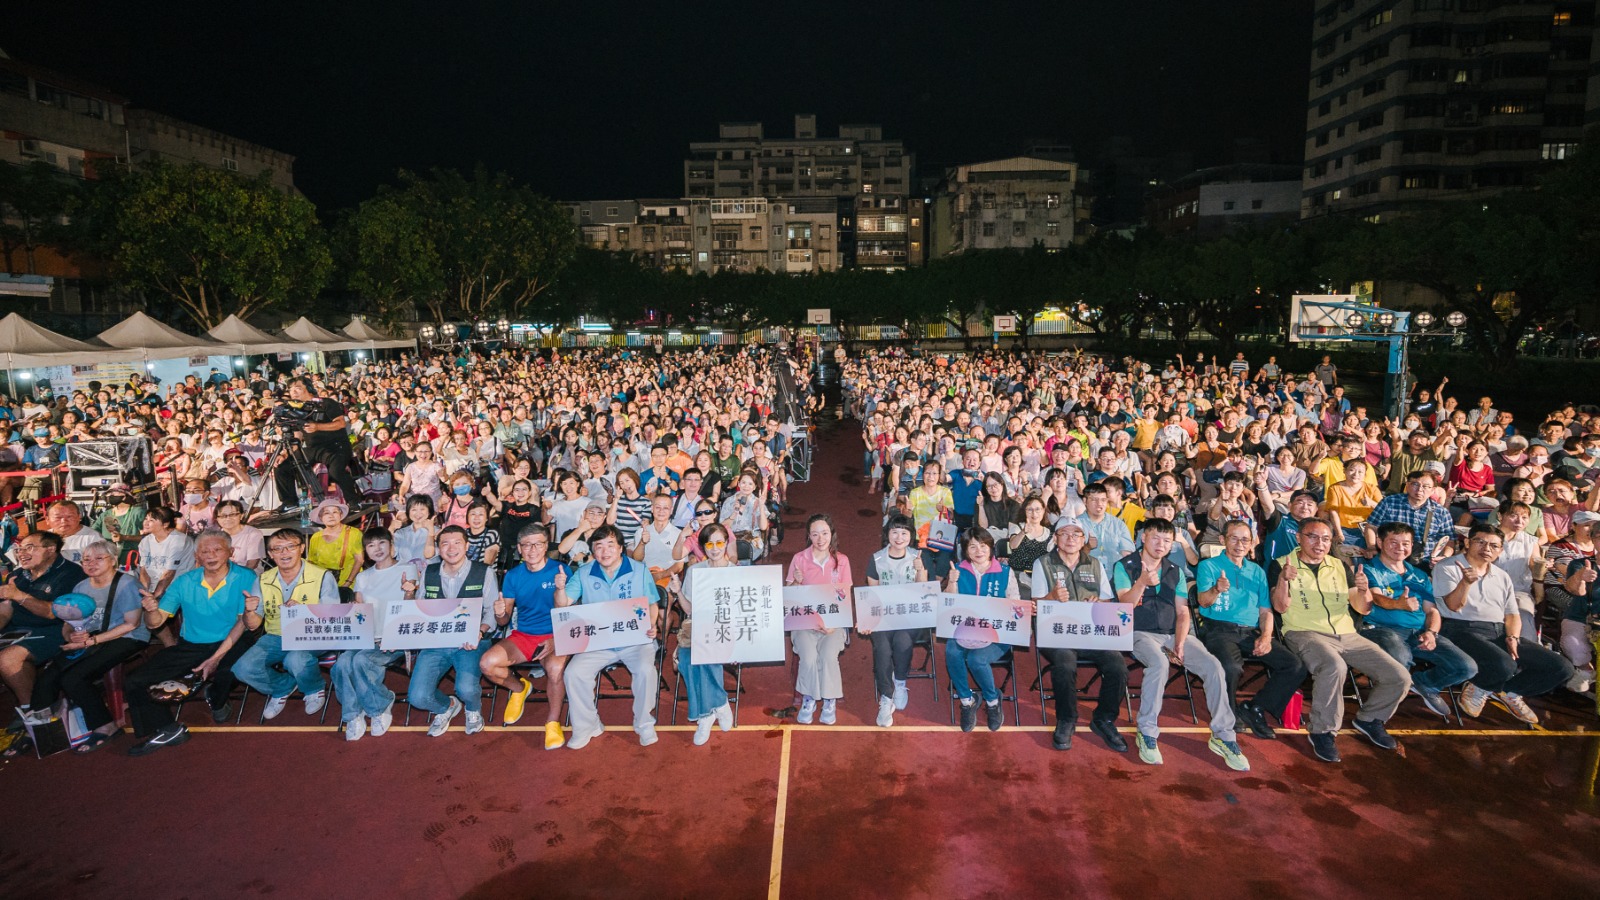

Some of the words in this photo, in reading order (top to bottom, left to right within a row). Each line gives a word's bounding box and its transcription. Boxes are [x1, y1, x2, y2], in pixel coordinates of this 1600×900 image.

[761, 584, 772, 609] 新北
[713, 586, 731, 643] 藝起來
[734, 586, 758, 642] 巷弄
[870, 601, 933, 617] 新北藝起來
[304, 617, 327, 625] 08.16
[328, 616, 352, 625] 泰山區
[304, 624, 352, 634] 民歌泰經典
[398, 620, 467, 636] 精彩零距離
[569, 618, 639, 639] 好歌一起唱
[950, 614, 1017, 632] 好戲在這裡
